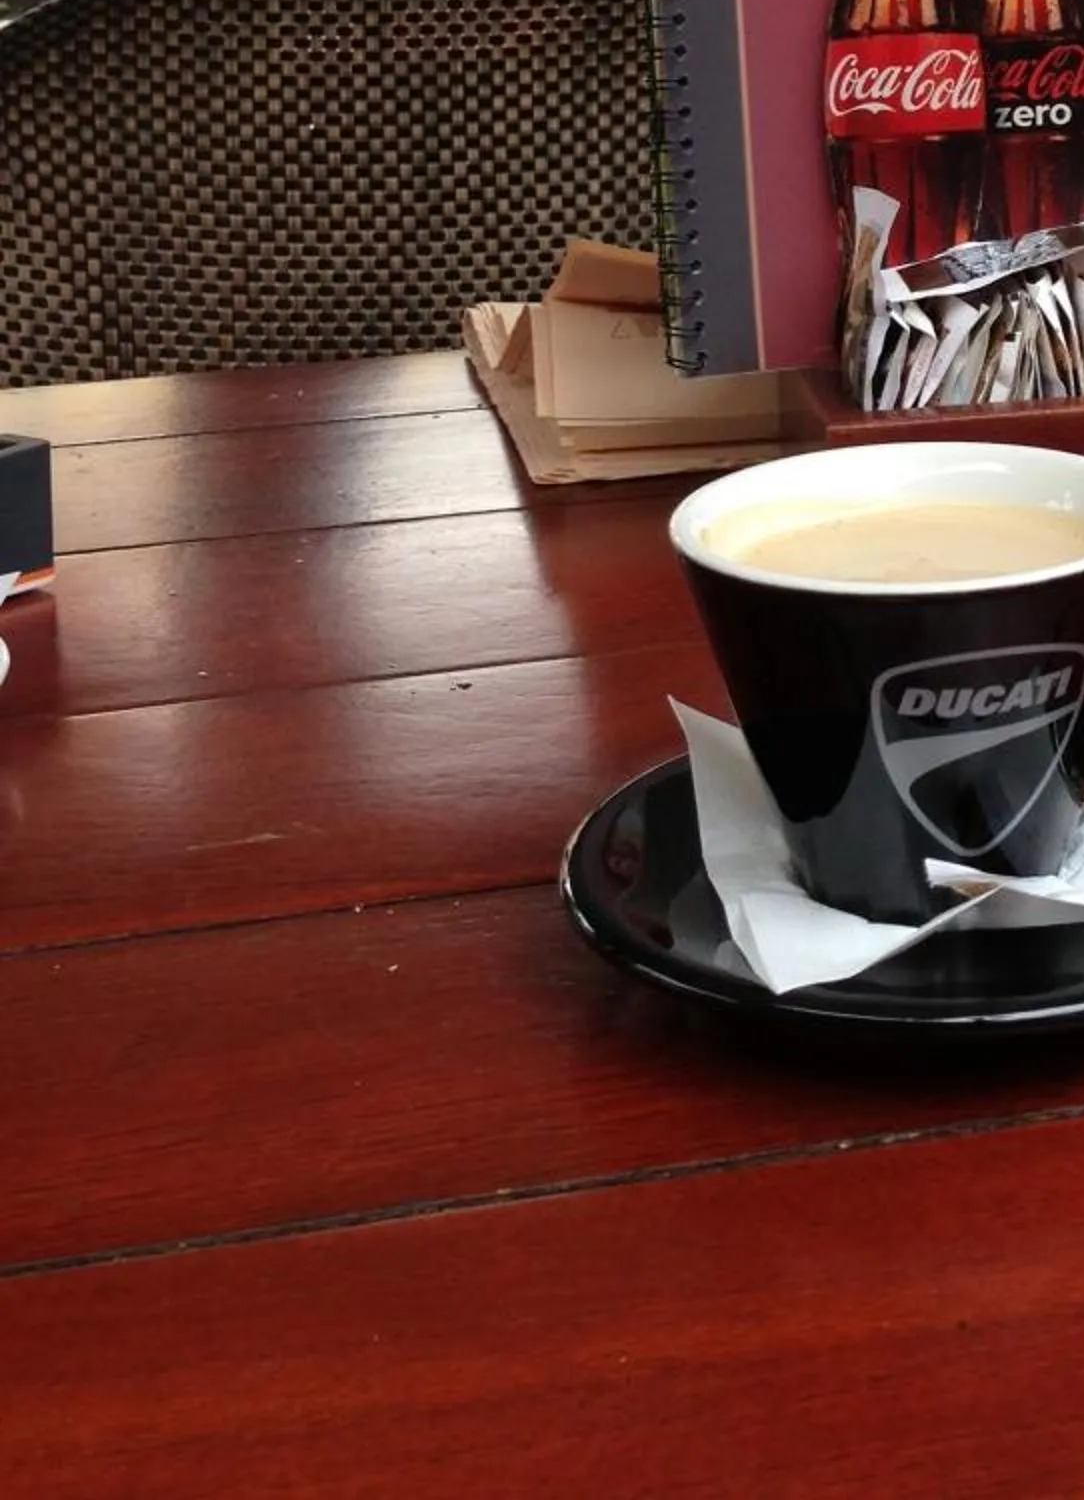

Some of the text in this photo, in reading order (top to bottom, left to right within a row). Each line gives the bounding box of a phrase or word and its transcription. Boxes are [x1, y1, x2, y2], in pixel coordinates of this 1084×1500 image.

[829, 48, 986, 117] Coca-Cola
[995, 103, 1072, 129] zero
[897, 666, 1073, 719] DUCATI
